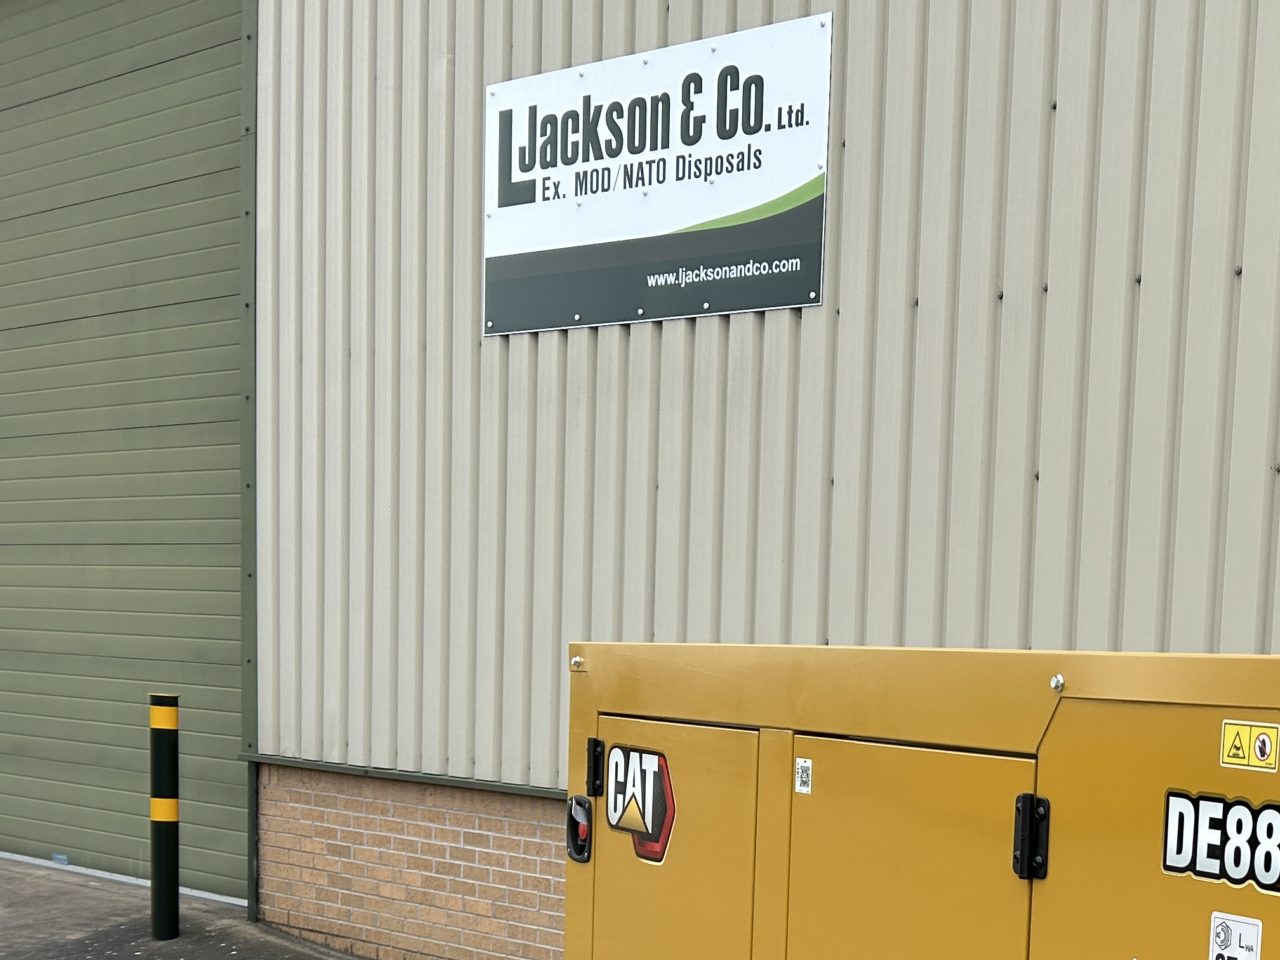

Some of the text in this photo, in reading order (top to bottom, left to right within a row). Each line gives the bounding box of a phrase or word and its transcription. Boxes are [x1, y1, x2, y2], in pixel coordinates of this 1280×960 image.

[680, 72, 707, 147] &
[716, 64, 772, 141] Co.
[777, 103, 810, 131] Ltd.
[541, 175, 567, 202] Ex.
[675, 143, 763, 182] Disposals
[646, 256, 801, 288] www.ljacksonandco.com
[608, 747, 659, 834] CAT
